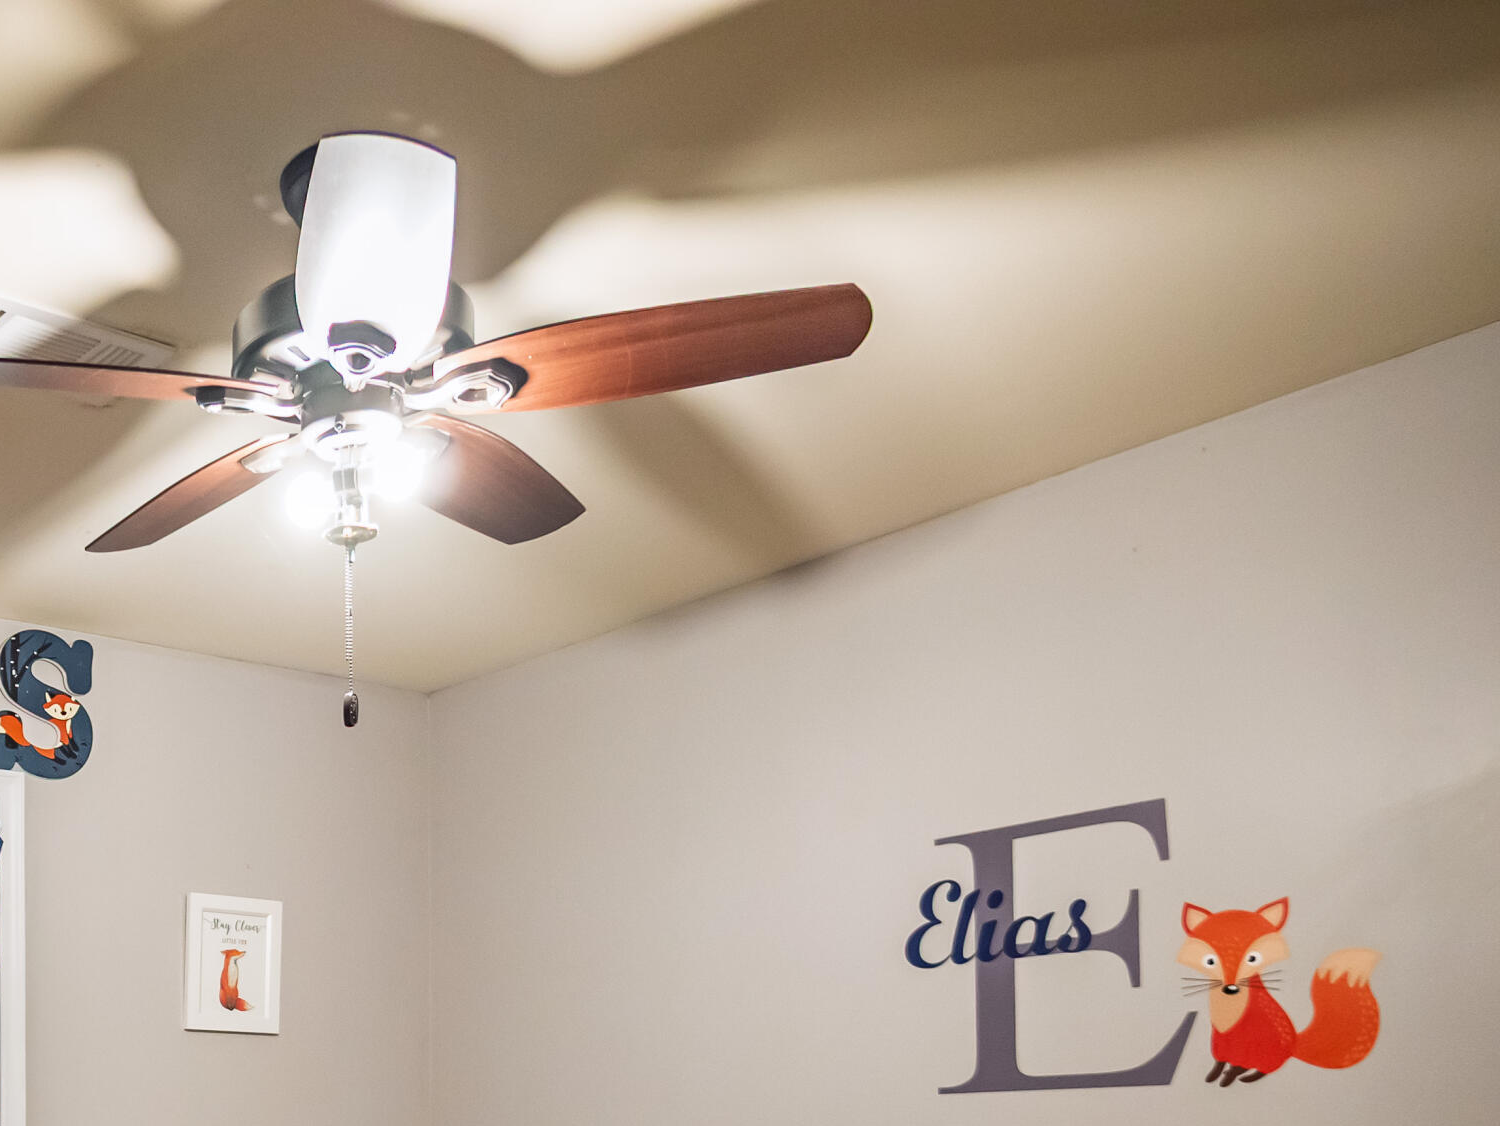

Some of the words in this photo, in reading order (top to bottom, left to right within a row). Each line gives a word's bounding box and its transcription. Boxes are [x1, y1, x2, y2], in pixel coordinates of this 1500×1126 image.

[211, 918, 230, 935] Stay
[904, 878, 1093, 969] Elias
[934, 797, 1198, 1095] E
